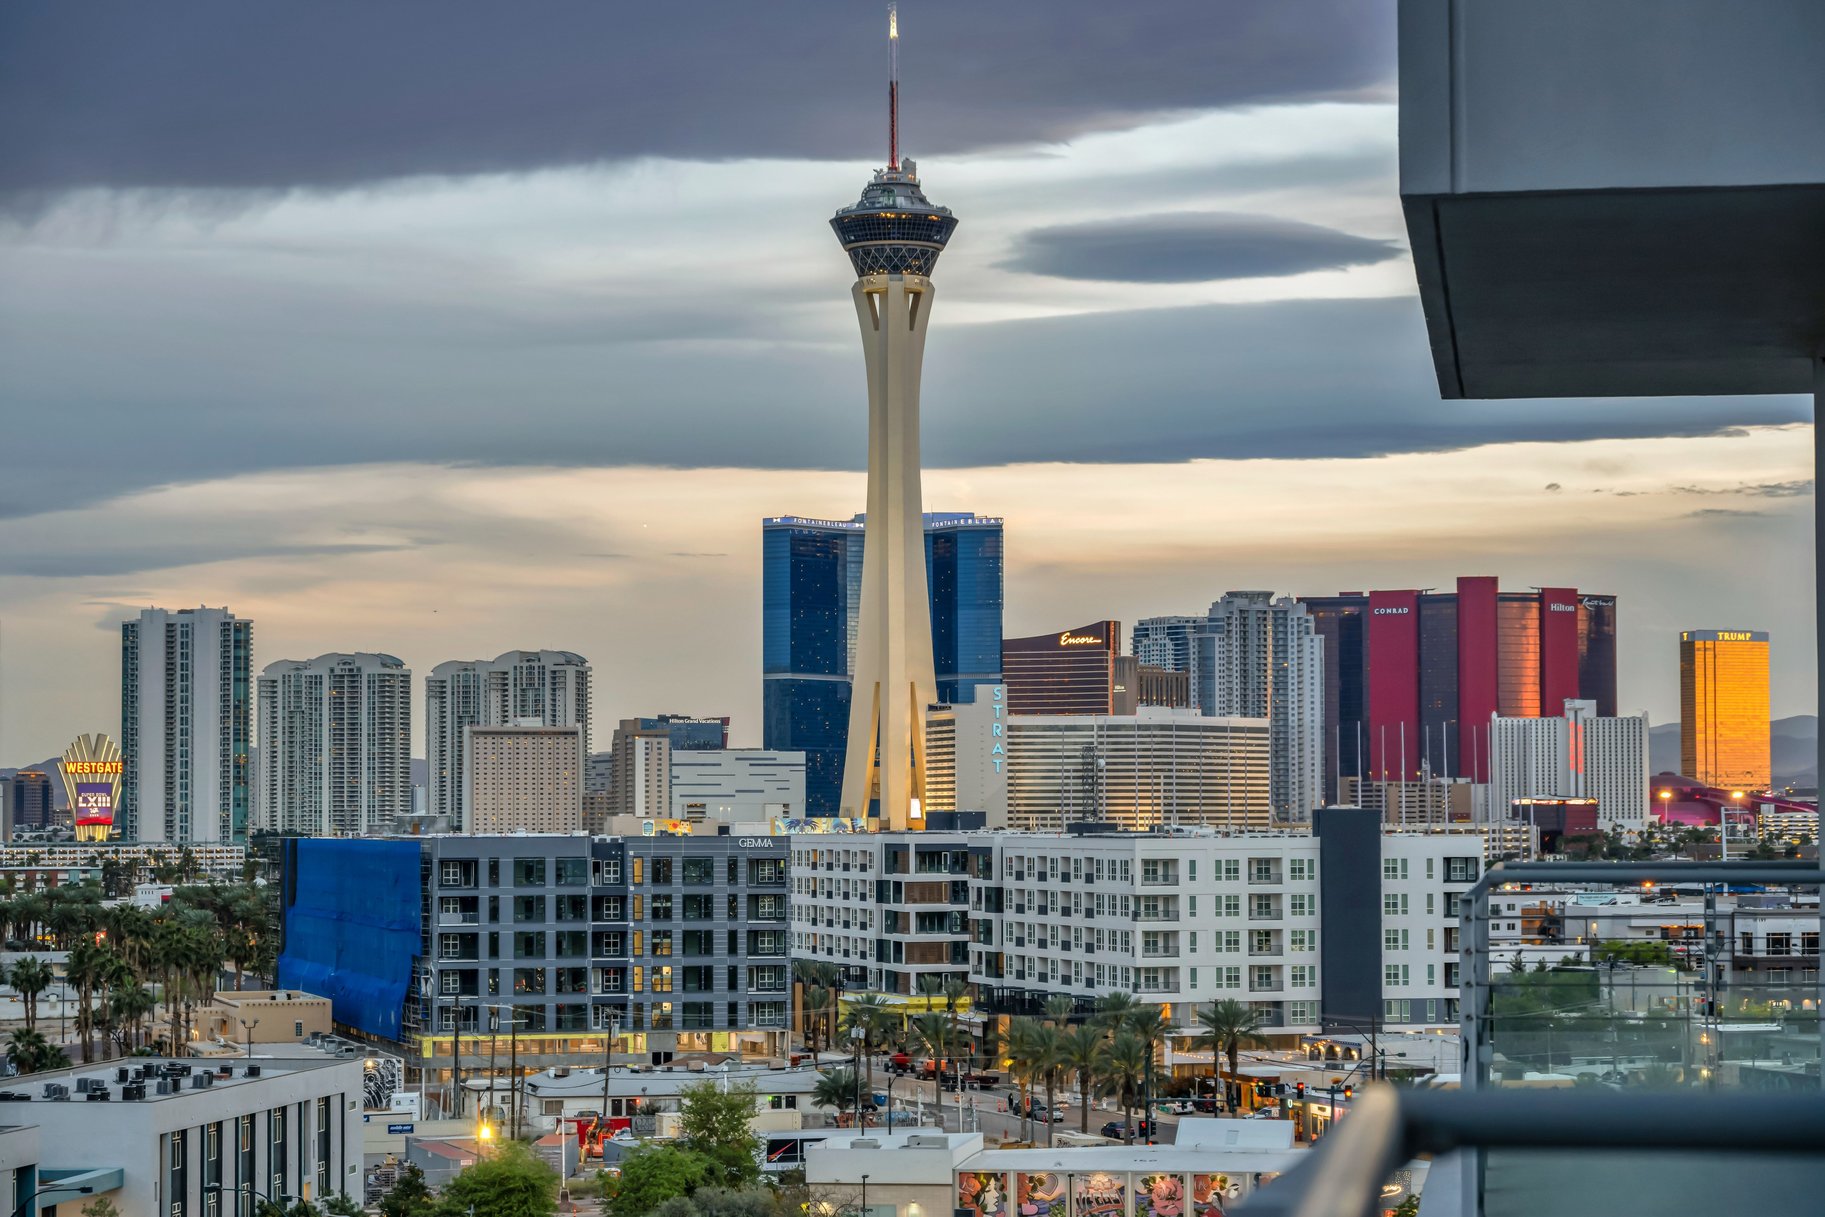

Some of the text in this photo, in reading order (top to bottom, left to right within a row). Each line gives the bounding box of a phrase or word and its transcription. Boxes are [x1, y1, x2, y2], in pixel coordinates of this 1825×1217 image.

[793, 517, 847, 528] FONTAINEBLEAU
[931, 518, 1004, 528] FONTAINEBLEAU
[1550, 603, 1575, 612] Hilton
[1060, 632, 1102, 646] Encore
[1717, 632, 1752, 640] TRUMP
[992, 687, 1004, 773] STRAT
[66, 762, 122, 773] WESTGATE
[78, 796, 110, 807] LXIII
[738, 838, 774, 848] GEMMA
